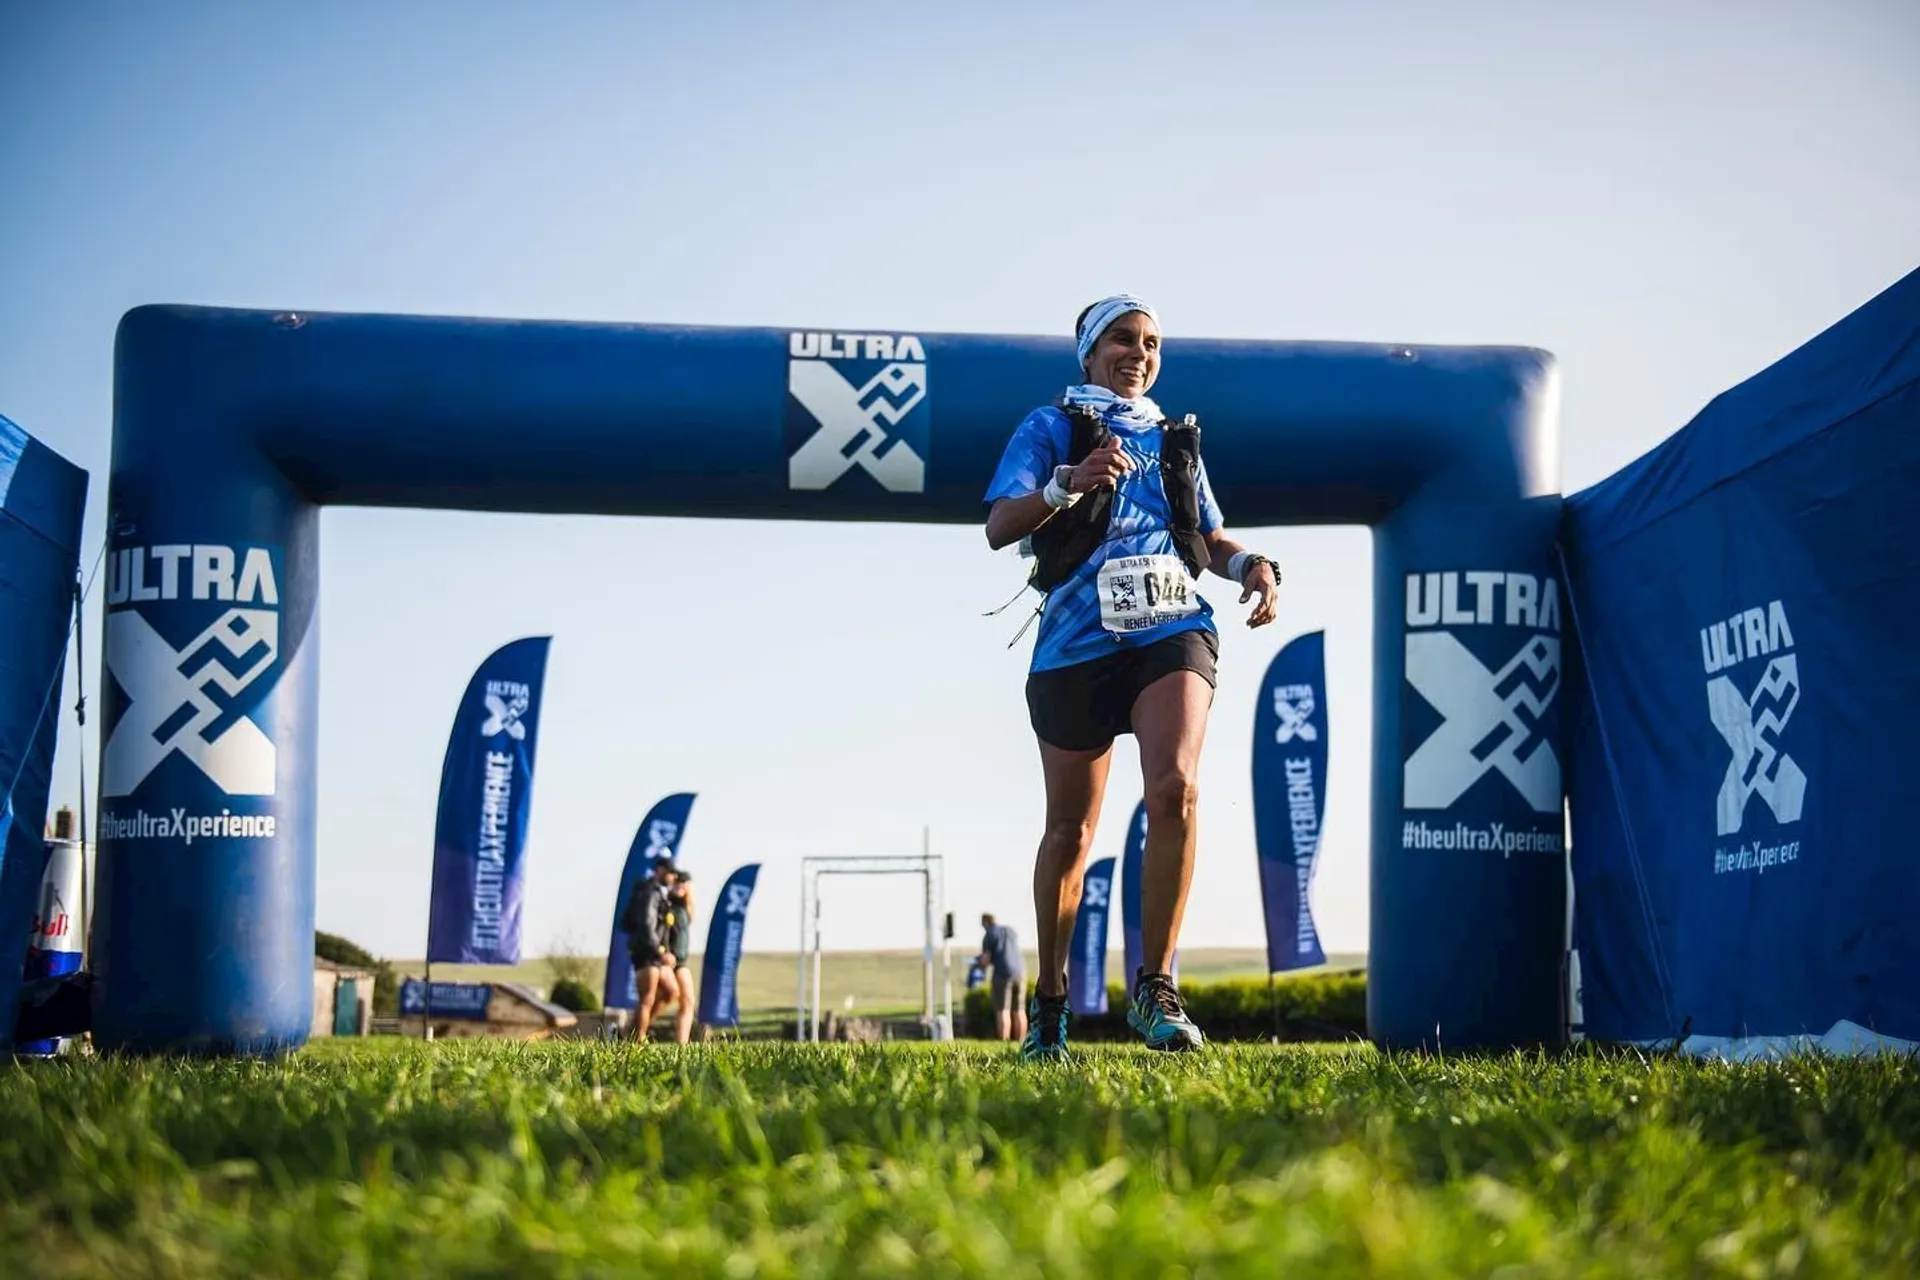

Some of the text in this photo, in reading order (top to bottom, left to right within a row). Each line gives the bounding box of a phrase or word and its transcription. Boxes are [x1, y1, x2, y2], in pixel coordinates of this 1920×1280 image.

[790, 332, 926, 360] ULTRA
[108, 544, 278, 605] ULTRA
[1144, 572, 1187, 606] 044
[1406, 570, 1561, 631] ULTRA
[1700, 599, 1794, 675] ULTRA
